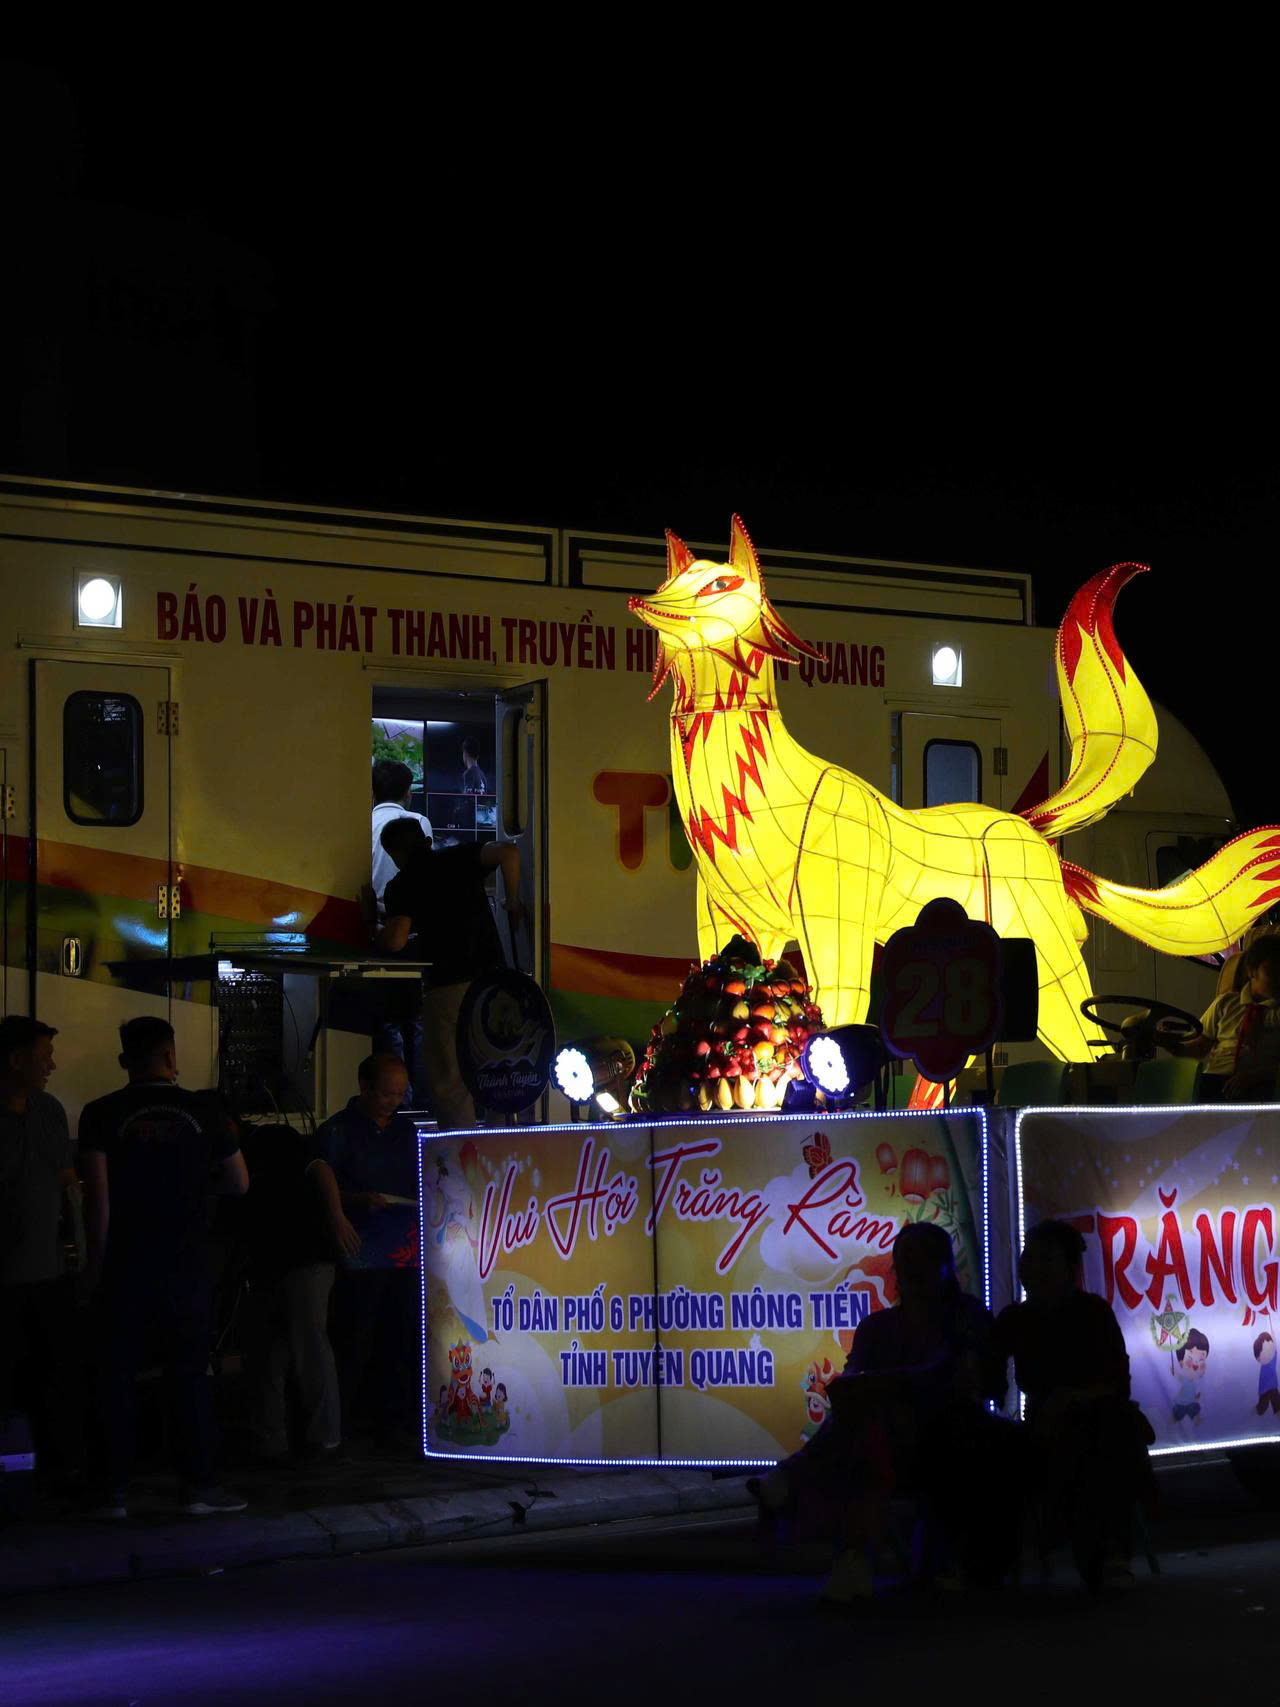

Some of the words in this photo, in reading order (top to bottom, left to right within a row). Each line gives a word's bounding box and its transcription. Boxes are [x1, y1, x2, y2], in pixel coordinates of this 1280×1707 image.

[157, 583, 227, 643] BÁO
[238, 588, 282, 647] VÀ
[293, 594, 377, 653] PHÁT
[501, 609, 616, 671] TRUYỀN
[800, 638, 885, 688] QUANG
[893, 957, 993, 1038] 28
[479, 1165, 538, 1279] Vui
[547, 1141, 637, 1255] Hội
[648, 1142, 771, 1270] Trăng
[783, 1161, 903, 1260] Rằm
[492, 1285, 515, 1331] TỔ
[519, 1291, 558, 1331] DÂN
[564, 1285, 605, 1331] PHỐ
[610, 1297, 623, 1331] 6
[630, 1287, 725, 1331] PHƯỜNG
[732, 1287, 803, 1329] NÔNG
[810, 1282, 870, 1328] TIẾN
[560, 1341, 606, 1385] TỈNH
[613, 1342, 684, 1386] TUYÊN
[691, 1350, 774, 1389] QUANG
